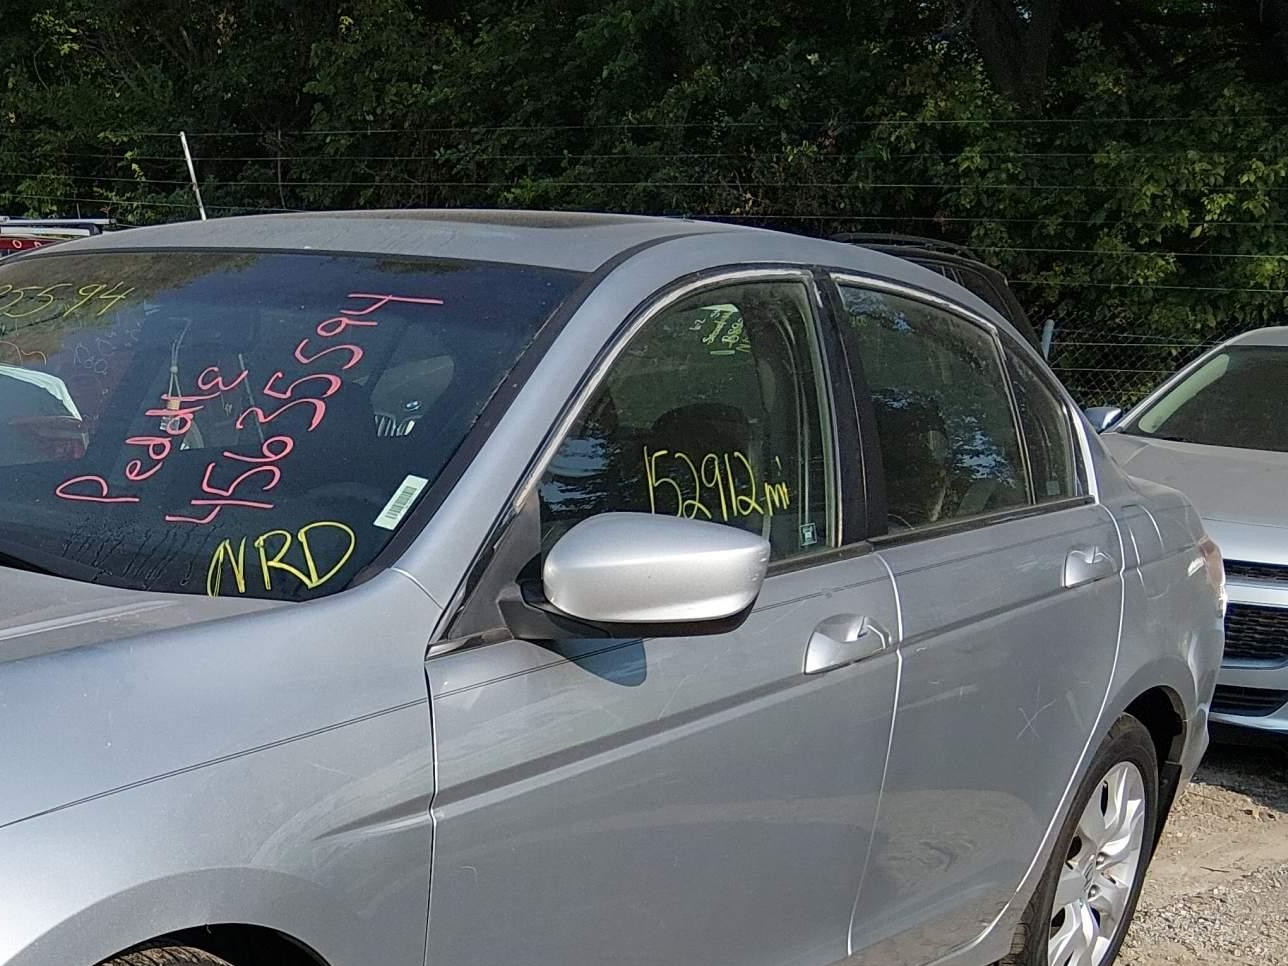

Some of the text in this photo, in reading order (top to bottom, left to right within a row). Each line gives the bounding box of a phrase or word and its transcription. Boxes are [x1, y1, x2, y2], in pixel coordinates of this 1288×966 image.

[164, 293, 444, 525] 45635594
[643, 445, 764, 522] 152912
[206, 520, 357, 600] NRD
